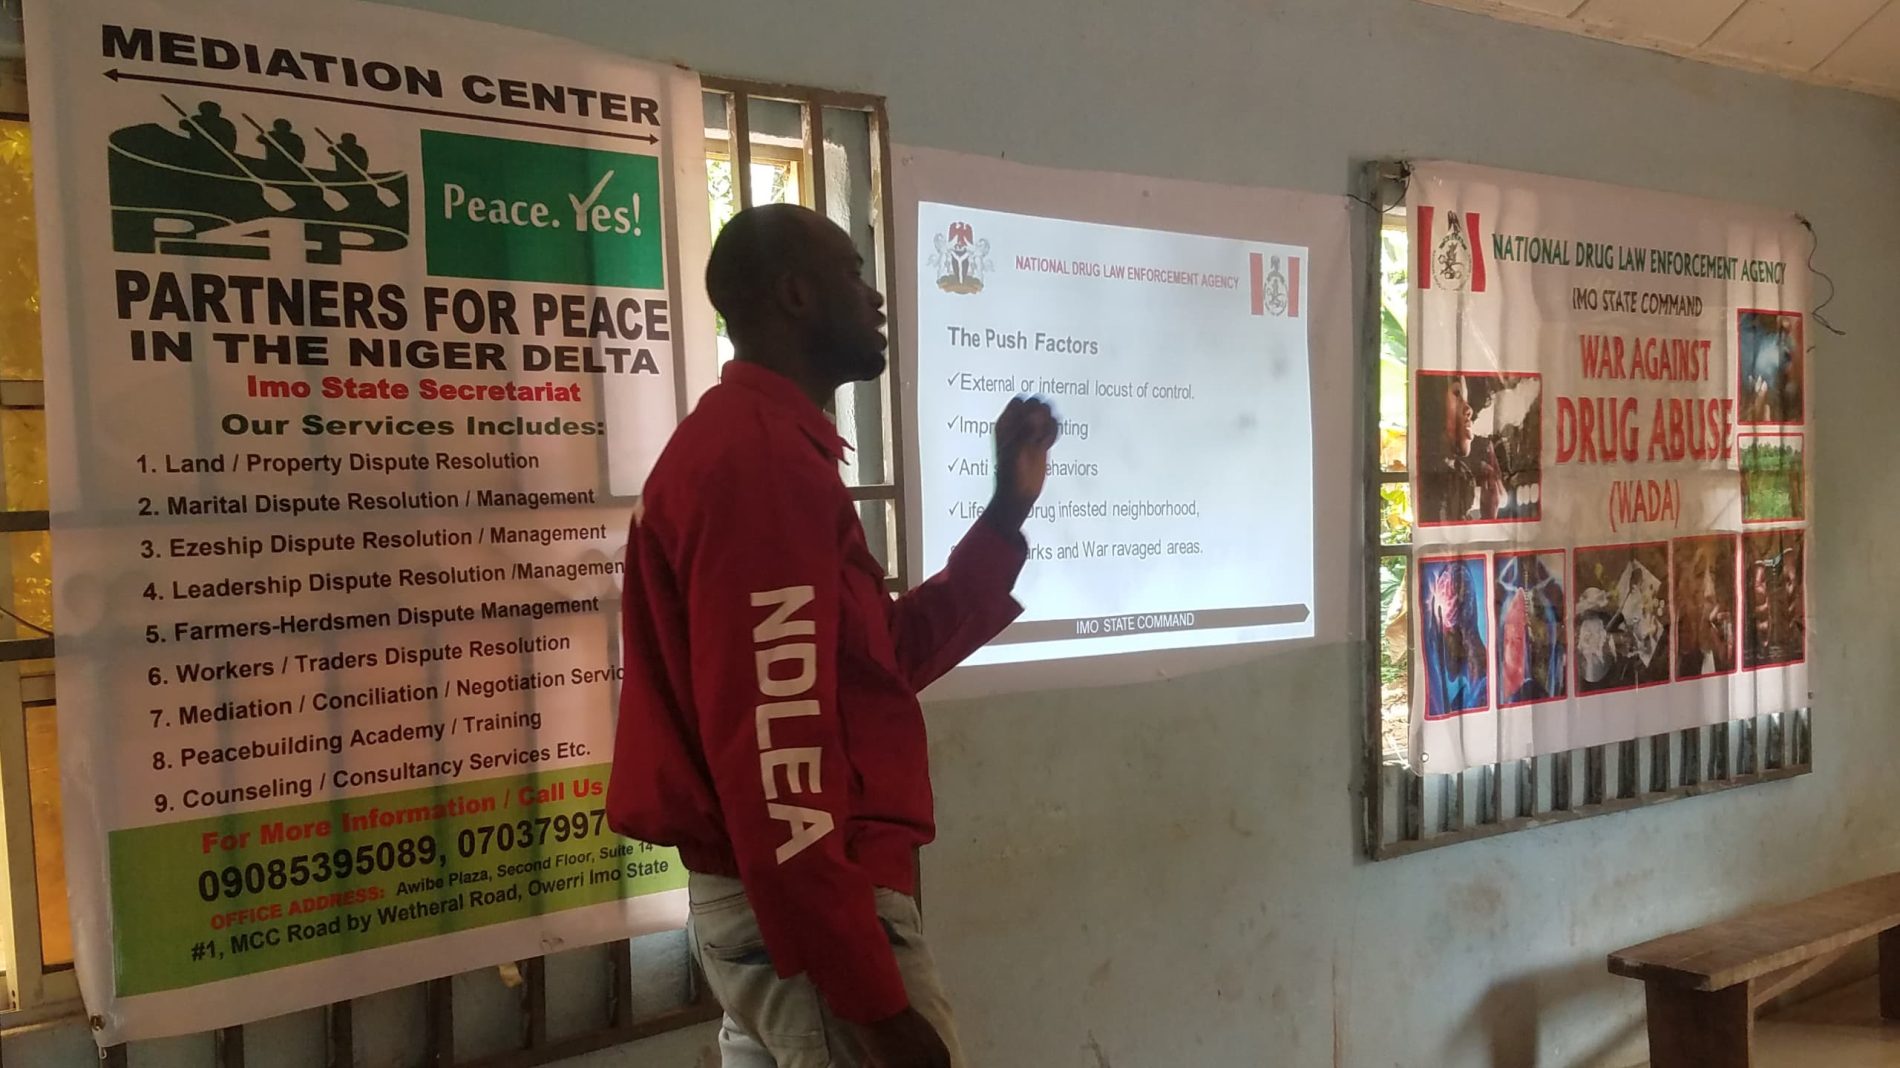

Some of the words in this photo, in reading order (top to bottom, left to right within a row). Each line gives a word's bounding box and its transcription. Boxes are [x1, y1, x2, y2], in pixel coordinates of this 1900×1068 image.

[101, 24, 443, 98] MEDIATION
[462, 74, 660, 126] CENTER
[443, 183, 559, 229] Peace.
[569, 170, 641, 237] Yes!
[1015, 255, 1070, 276] NATIONAL
[1072, 260, 1100, 277] DRUG
[1103, 264, 1125, 279] LAW
[1127, 265, 1198, 287] ENFORCEMENT
[1202, 274, 1239, 289] AGENCY
[1492, 233, 1570, 267] NATIONAL
[1575, 242, 1614, 270] DRUG
[1618, 246, 1646, 273] LAW
[1650, 250, 1737, 282] ENFORCEMENT
[1740, 258, 1787, 286] AGENCY
[115, 270, 408, 331] PARTNERS
[424, 287, 520, 336] FOR
[534, 293, 670, 342] PEACE
[1572, 288, 1598, 311] IMO
[1602, 289, 1637, 314] STATE
[1640, 291, 1703, 318] COMMAND
[131, 330, 192, 362] IN
[213, 333, 329, 367] THE
[349, 337, 508, 371] NIGER
[523, 345, 659, 375] DELTA
[947, 326, 980, 348] The
[985, 328, 1027, 350] Push
[1034, 332, 1099, 355] Factors
[1579, 333, 1627, 380] WAR
[1630, 337, 1711, 382] AGAINST
[247, 375, 311, 400] Imo
[321, 377, 409, 401] State
[419, 379, 581, 403] Secretariat
[960, 373, 1015, 393] External
[1021, 379, 1034, 393] or
[1038, 377, 1089, 396] internal
[1095, 379, 1133, 398] locust
[1136, 382, 1149, 398] of
[1151, 382, 1195, 401] control.
[221, 413, 289, 436] Our
[301, 414, 455, 436] Services
[467, 416, 605, 437] Includes:
[1555, 395, 1639, 465] DRUG
[1648, 397, 1734, 463] ABUSE
[136, 455, 157, 474] 1.
[165, 453, 225, 474] Land
[232, 453, 239, 474] /
[246, 453, 342, 476] Property
[349, 452, 430, 474] Dispute
[436, 453, 539, 471] Resolution
[959, 458, 989, 476] Anti
[1046, 460, 1098, 476] ehaviors
[138, 497, 160, 517] 2.
[167, 495, 248, 516] Marital
[255, 493, 341, 516] Dispute
[347, 492, 459, 510] Resolution
[465, 489, 471, 508] /
[477, 490, 595, 510] Management
[1058, 500, 1107, 518] infested
[1112, 499, 1200, 521] neighborhood,
[1608, 478, 1681, 533] (WADA)
[140, 539, 162, 559] 3.
[169, 538, 263, 560] Ezeship
[270, 535, 356, 556] Dispute
[362, 531, 473, 548] Resolution
[479, 527, 484, 545] /
[490, 525, 607, 545] Management
[1057, 542, 1079, 558] and
[1083, 541, 1108, 557] War
[1111, 541, 1162, 560] ravaged
[1167, 540, 1203, 555] areas.
[143, 582, 164, 602] 4.
[172, 576, 301, 600] Leadership
[308, 572, 392, 594] Dispute
[399, 566, 505, 587] Resolution
[512, 561, 624, 581] /Managemen
[146, 624, 167, 644] 5.
[174, 613, 391, 642] Farmers-Herdsmen
[398, 608, 475, 627] Dispute
[481, 596, 599, 619] Management
[1076, 620, 1100, 635] IMO
[1103, 617, 1135, 633] STATE
[1137, 613, 1195, 630] COMMAND
[148, 667, 169, 686] 6.
[176, 660, 275, 684] Workers
[281, 656, 288, 675] /
[294, 652, 378, 672] Traders
[385, 645, 463, 666] Dispute
[469, 636, 570, 657] Resolution
[150, 709, 171, 729] 7.
[179, 700, 293, 725] Mediation
[299, 694, 305, 714] /
[312, 684, 439, 711] Conciliation
[445, 680, 451, 698] /
[456, 671, 565, 697] Negotiation
[571, 665, 624, 684] Servic
[153, 751, 173, 771] 8.
[180, 734, 343, 766] Peacebuilding
[350, 724, 445, 747] Academy
[451, 717, 457, 736] /
[463, 711, 542, 733] Training
[751, 585, 834, 865] NDLEA
[154, 793, 175, 813] 9.
[182, 778, 313, 807] Counseling
[319, 773, 326, 792] /
[332, 759, 463, 788] Consultancy
[469, 748, 552, 770] Services
[556, 740, 591, 761] Etc.
[202, 831, 250, 854] For
[260, 818, 331, 845] More
[341, 793, 496, 830] Information
[503, 789, 510, 811] /
[518, 782, 565, 806] Call
[573, 778, 603, 799] Us
[198, 836, 447, 901] 09085395089,
[458, 808, 606, 858] 07037997
[211, 905, 283, 929] OFFICE
[288, 886, 385, 916] ADDRESS:
[396, 876, 444, 897] Awibe
[449, 868, 493, 887] Plaza,
[497, 859, 551, 878] Second
[556, 852, 596, 867] Floor,
[600, 844, 634, 859] Suite
[191, 940, 224, 962] #1,
[230, 928, 281, 954] MCC
[288, 916, 341, 942] Road
[347, 913, 372, 933] by
[378, 893, 464, 926] Wetheral
[470, 884, 522, 908] Road,
[528, 872, 584, 897] Owerri
[590, 869, 621, 885] Imo
[626, 860, 669, 878] State
